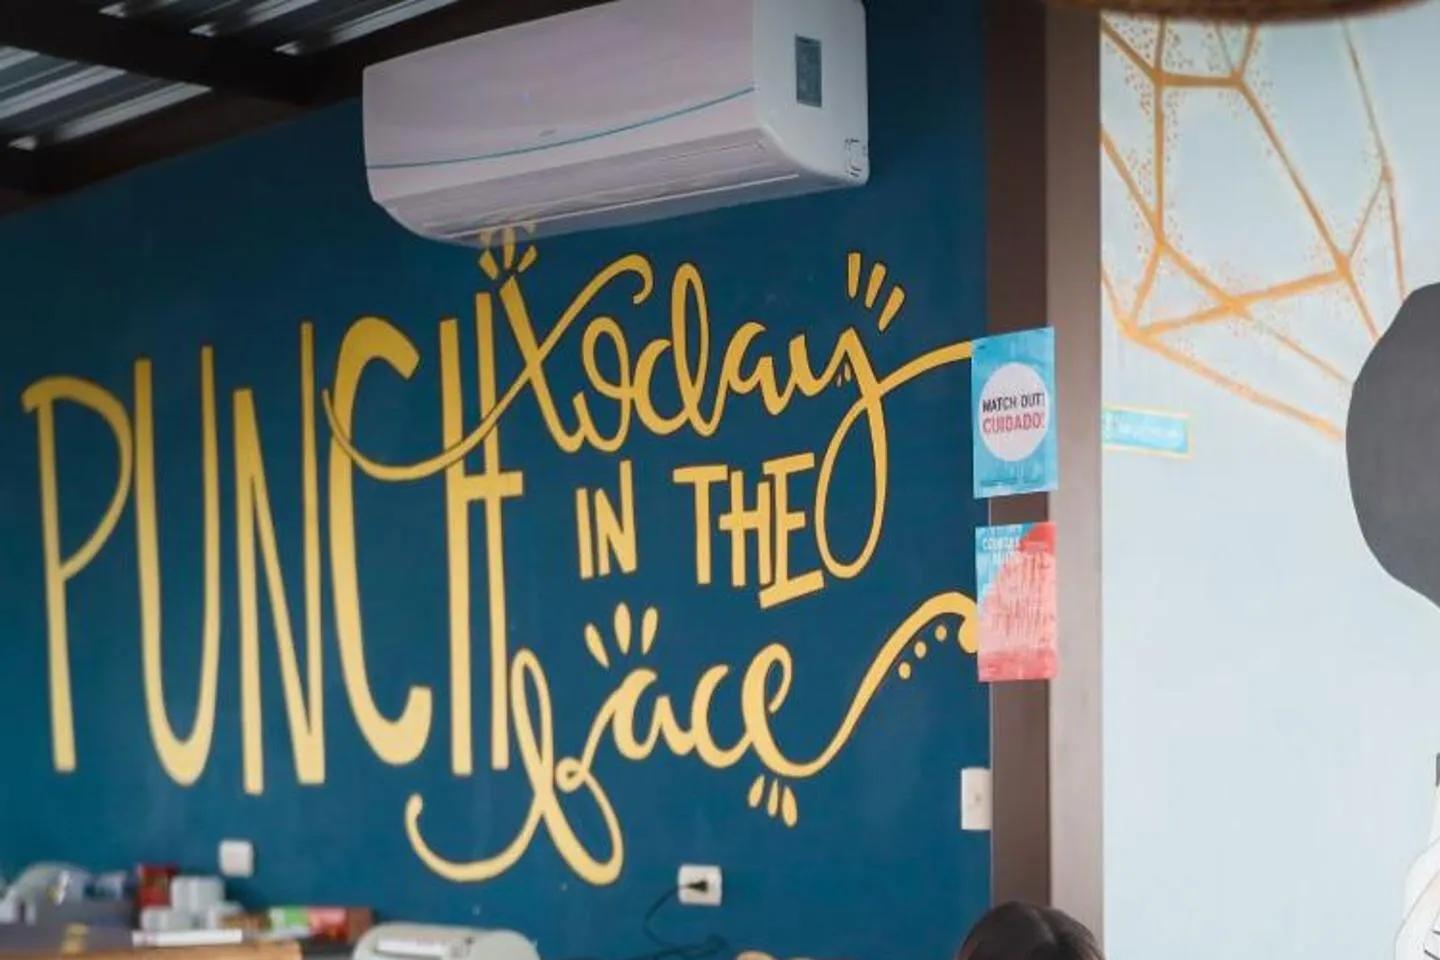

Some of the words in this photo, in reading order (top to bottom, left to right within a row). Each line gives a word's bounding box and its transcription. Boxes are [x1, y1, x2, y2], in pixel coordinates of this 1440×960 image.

[21, 291, 523, 795] PUNCH
[576, 460, 637, 580] IN
[673, 453, 824, 609] THE
